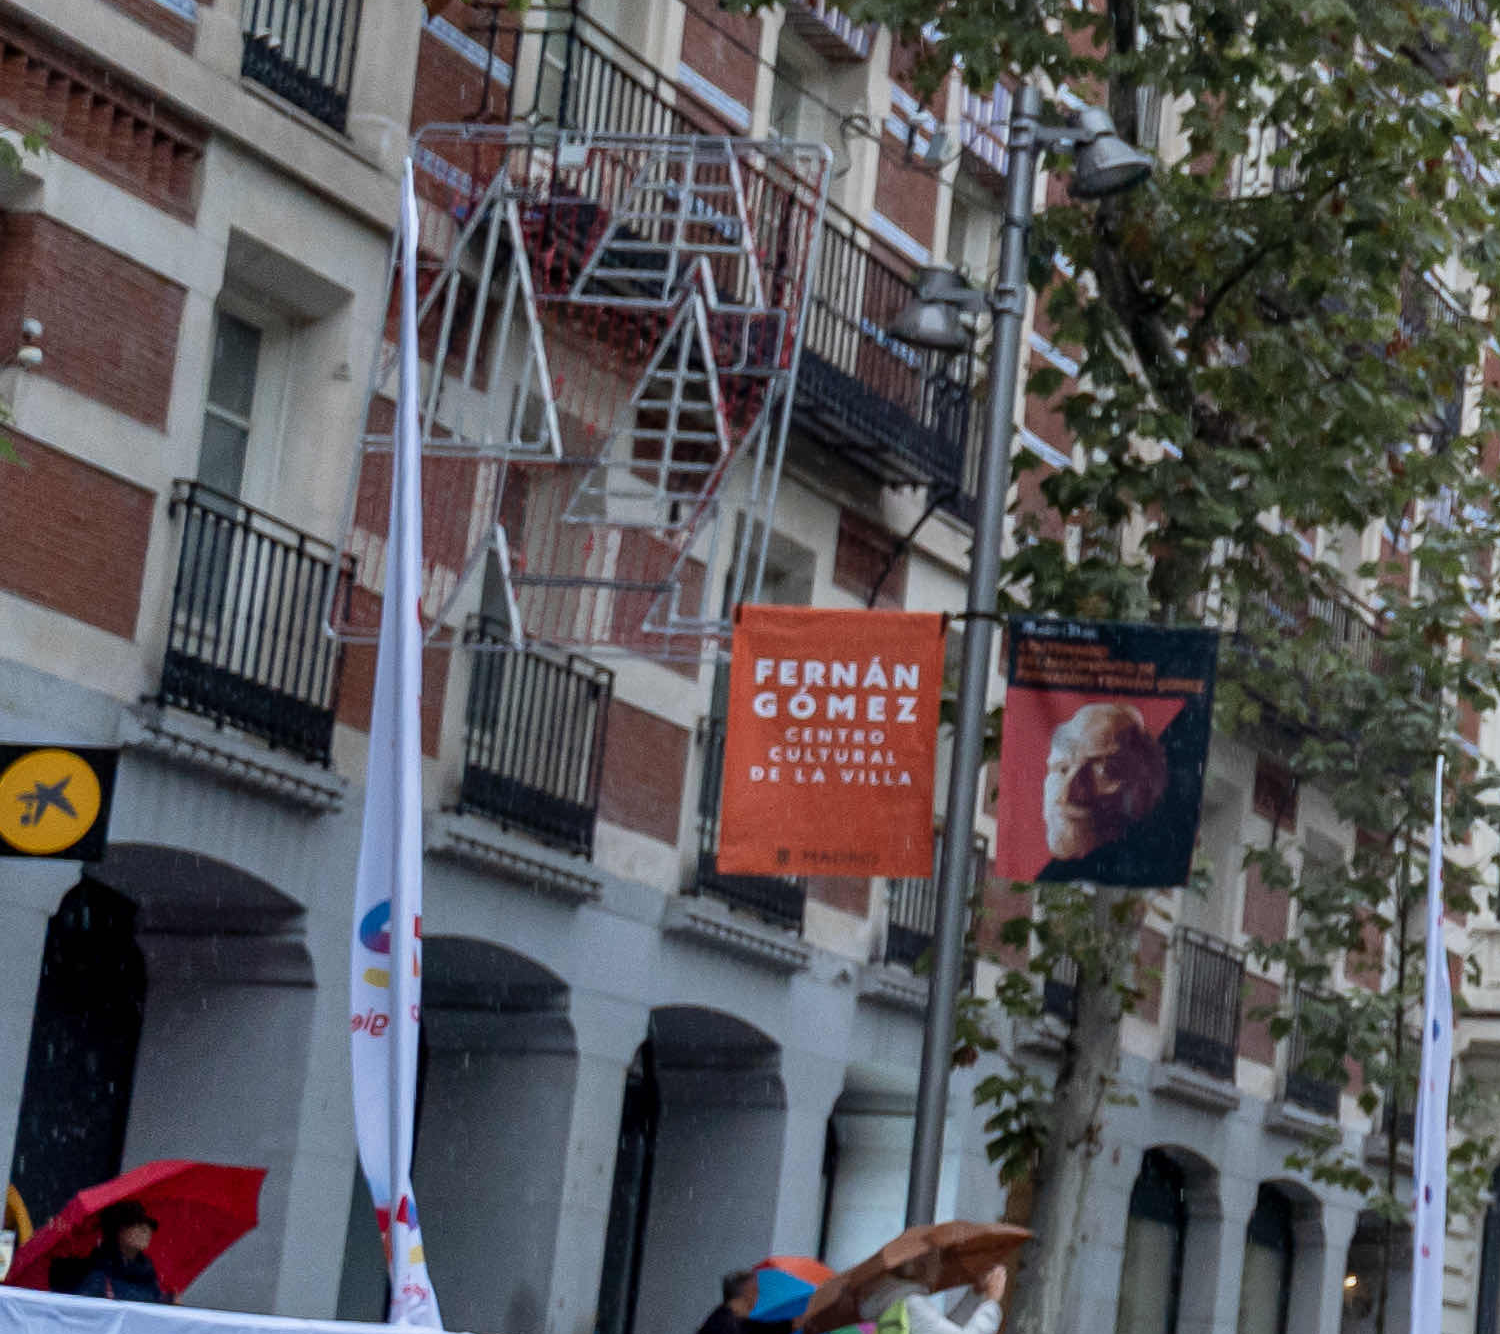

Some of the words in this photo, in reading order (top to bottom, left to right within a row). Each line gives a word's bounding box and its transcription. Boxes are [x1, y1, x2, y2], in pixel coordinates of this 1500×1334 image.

[755, 655, 920, 690] FERNÁN
[753, 686, 918, 723] GÓMEZ
[785, 727, 885, 745] CENTRO
[768, 746, 896, 765] CULTURAL
[750, 765, 780, 783] DE
[795, 767, 826, 784] LA
[840, 768, 912, 786] VILLA
